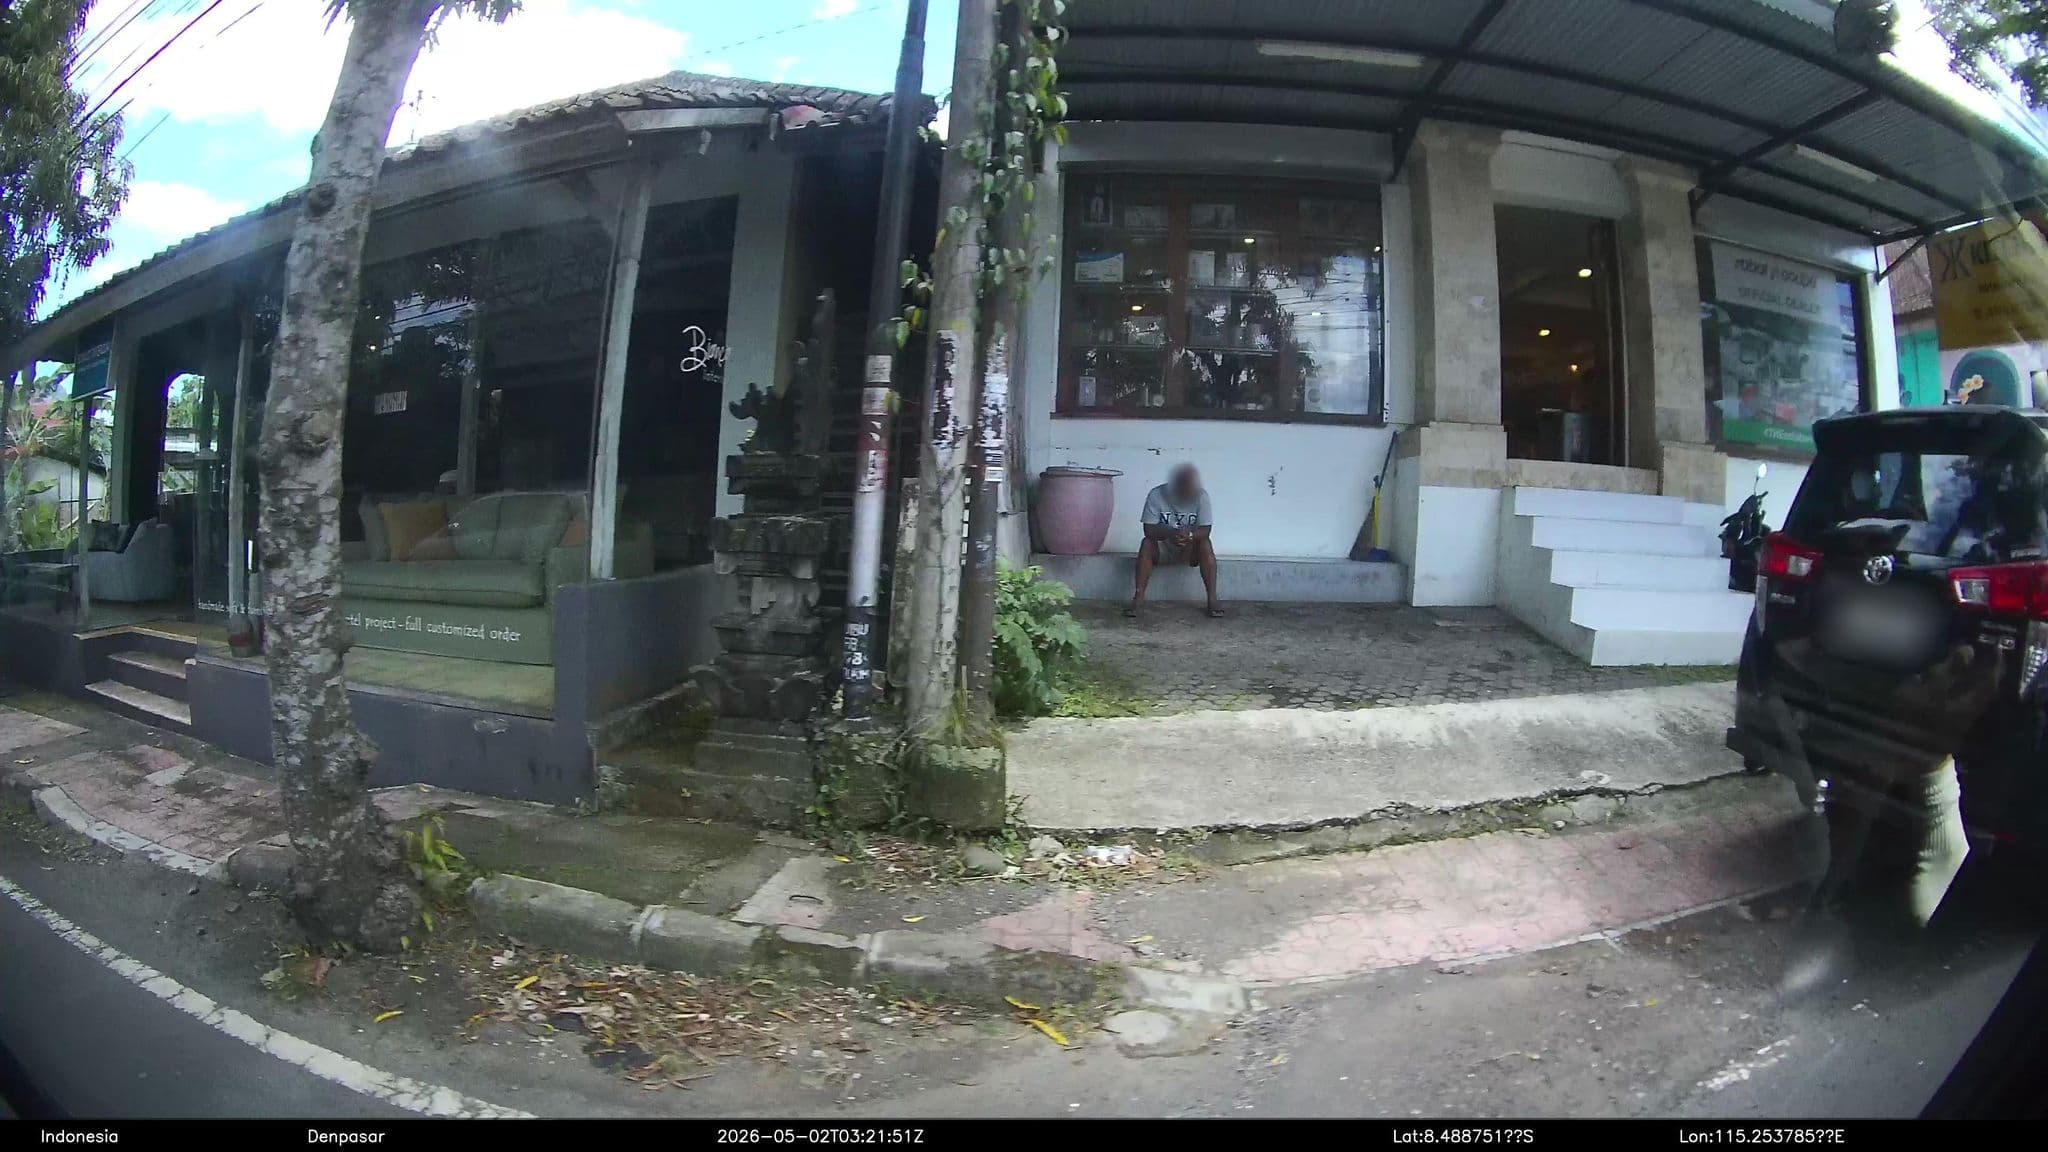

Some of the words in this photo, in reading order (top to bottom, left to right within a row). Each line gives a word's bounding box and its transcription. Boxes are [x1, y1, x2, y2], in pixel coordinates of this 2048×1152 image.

[365, 616, 397, 633] project
[405, 615, 422, 632] full
[427, 622, 486, 640] customized
[489, 626, 521, 643] order
